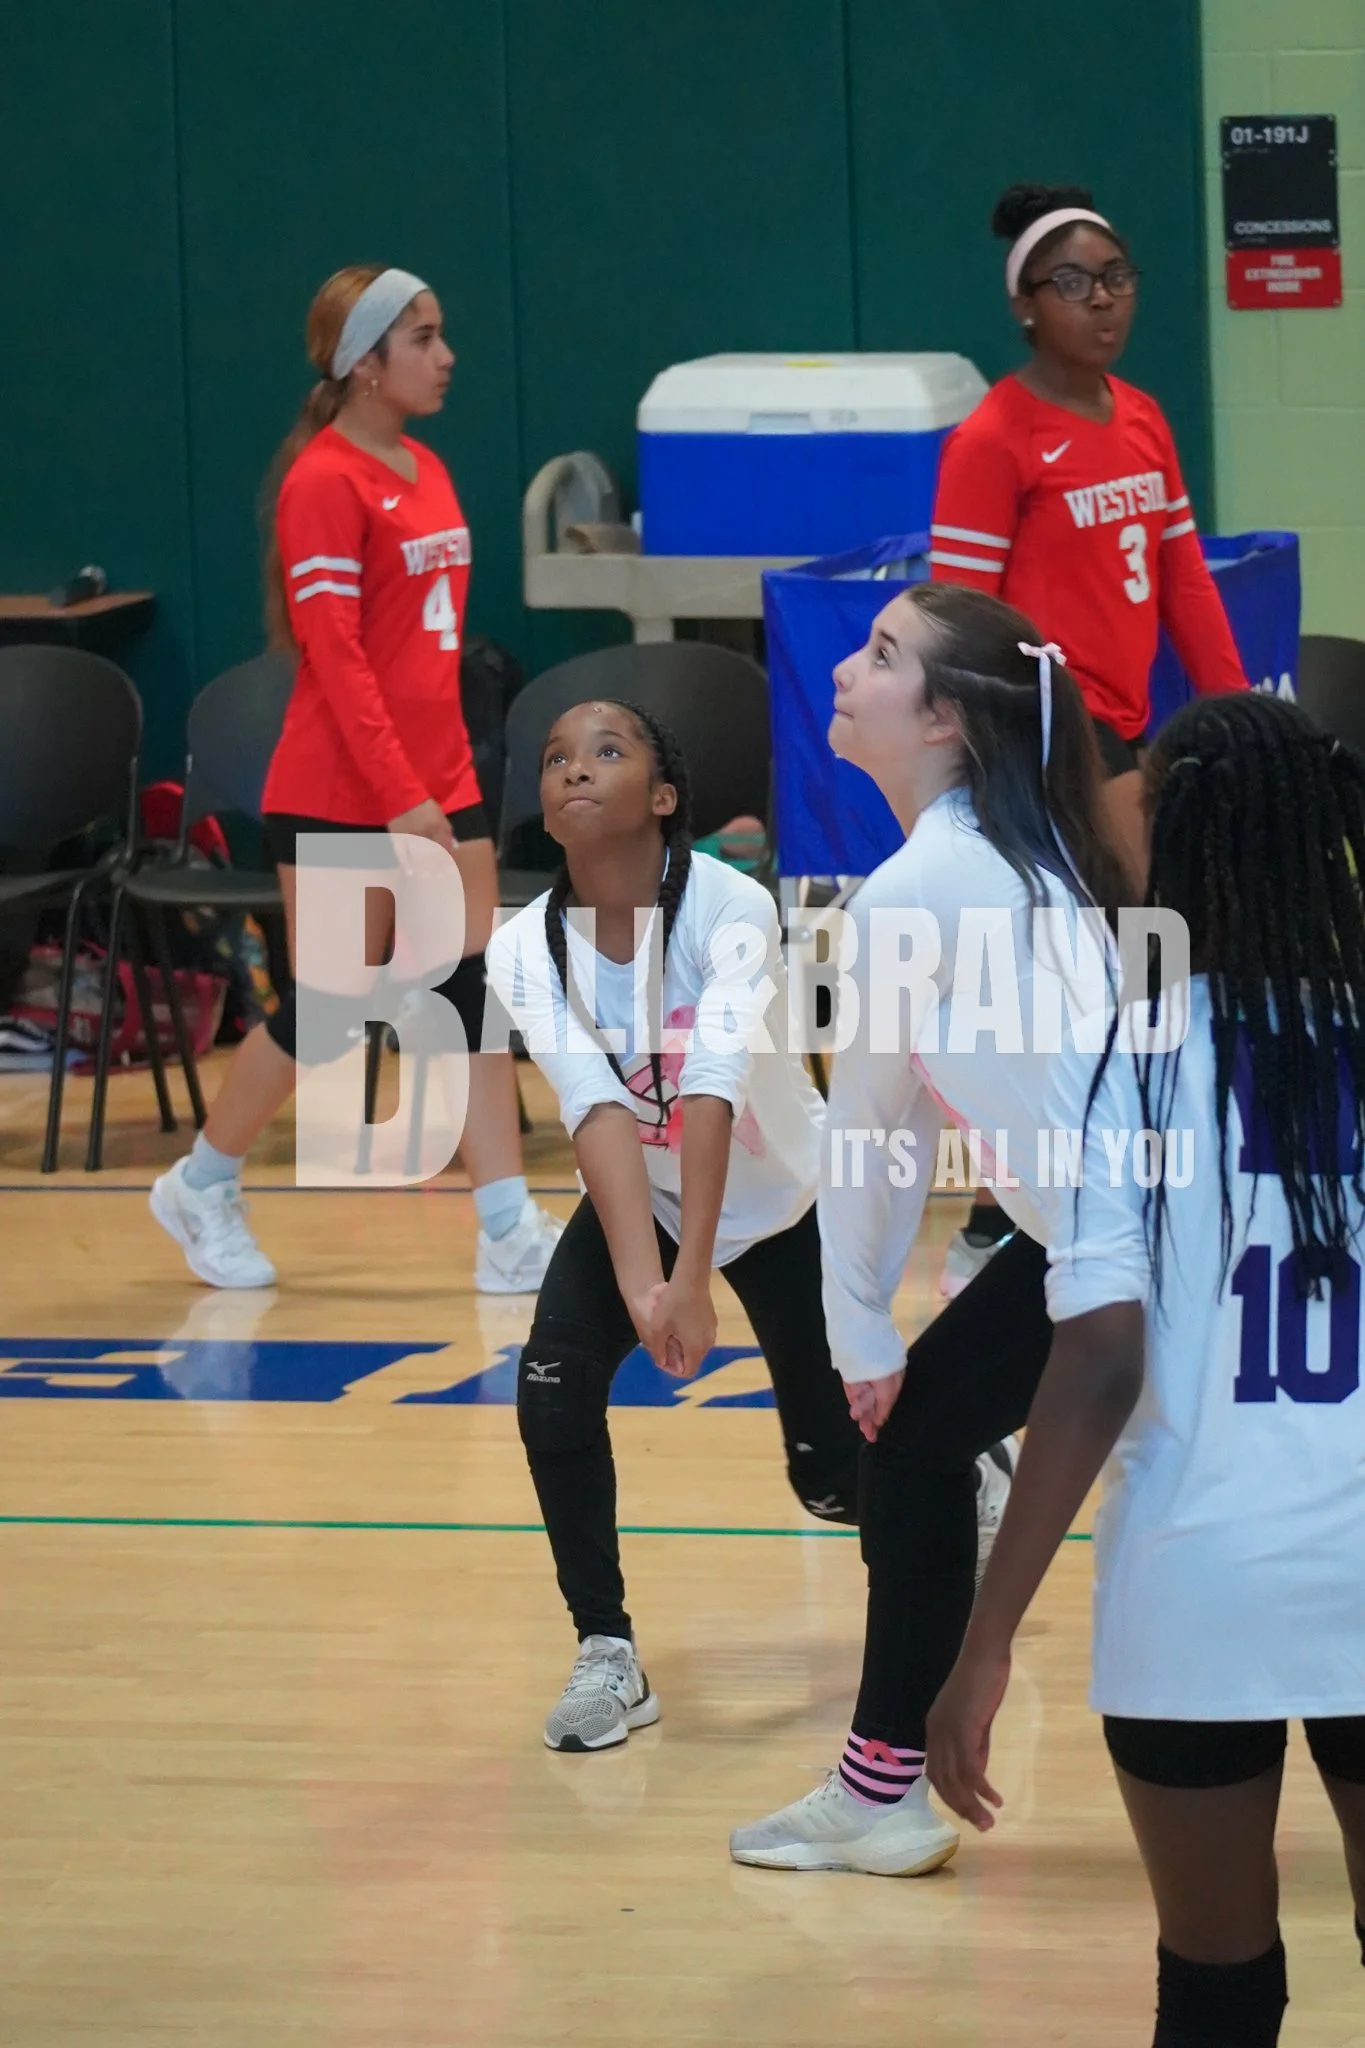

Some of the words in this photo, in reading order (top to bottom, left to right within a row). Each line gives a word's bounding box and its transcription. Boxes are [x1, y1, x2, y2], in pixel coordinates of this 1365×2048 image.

[1231, 126, 1309, 145] 01-191J
[1119, 523, 1150, 604] 3
[423, 573, 459, 651] 4
[1231, 1244, 1361, 1404] 10
